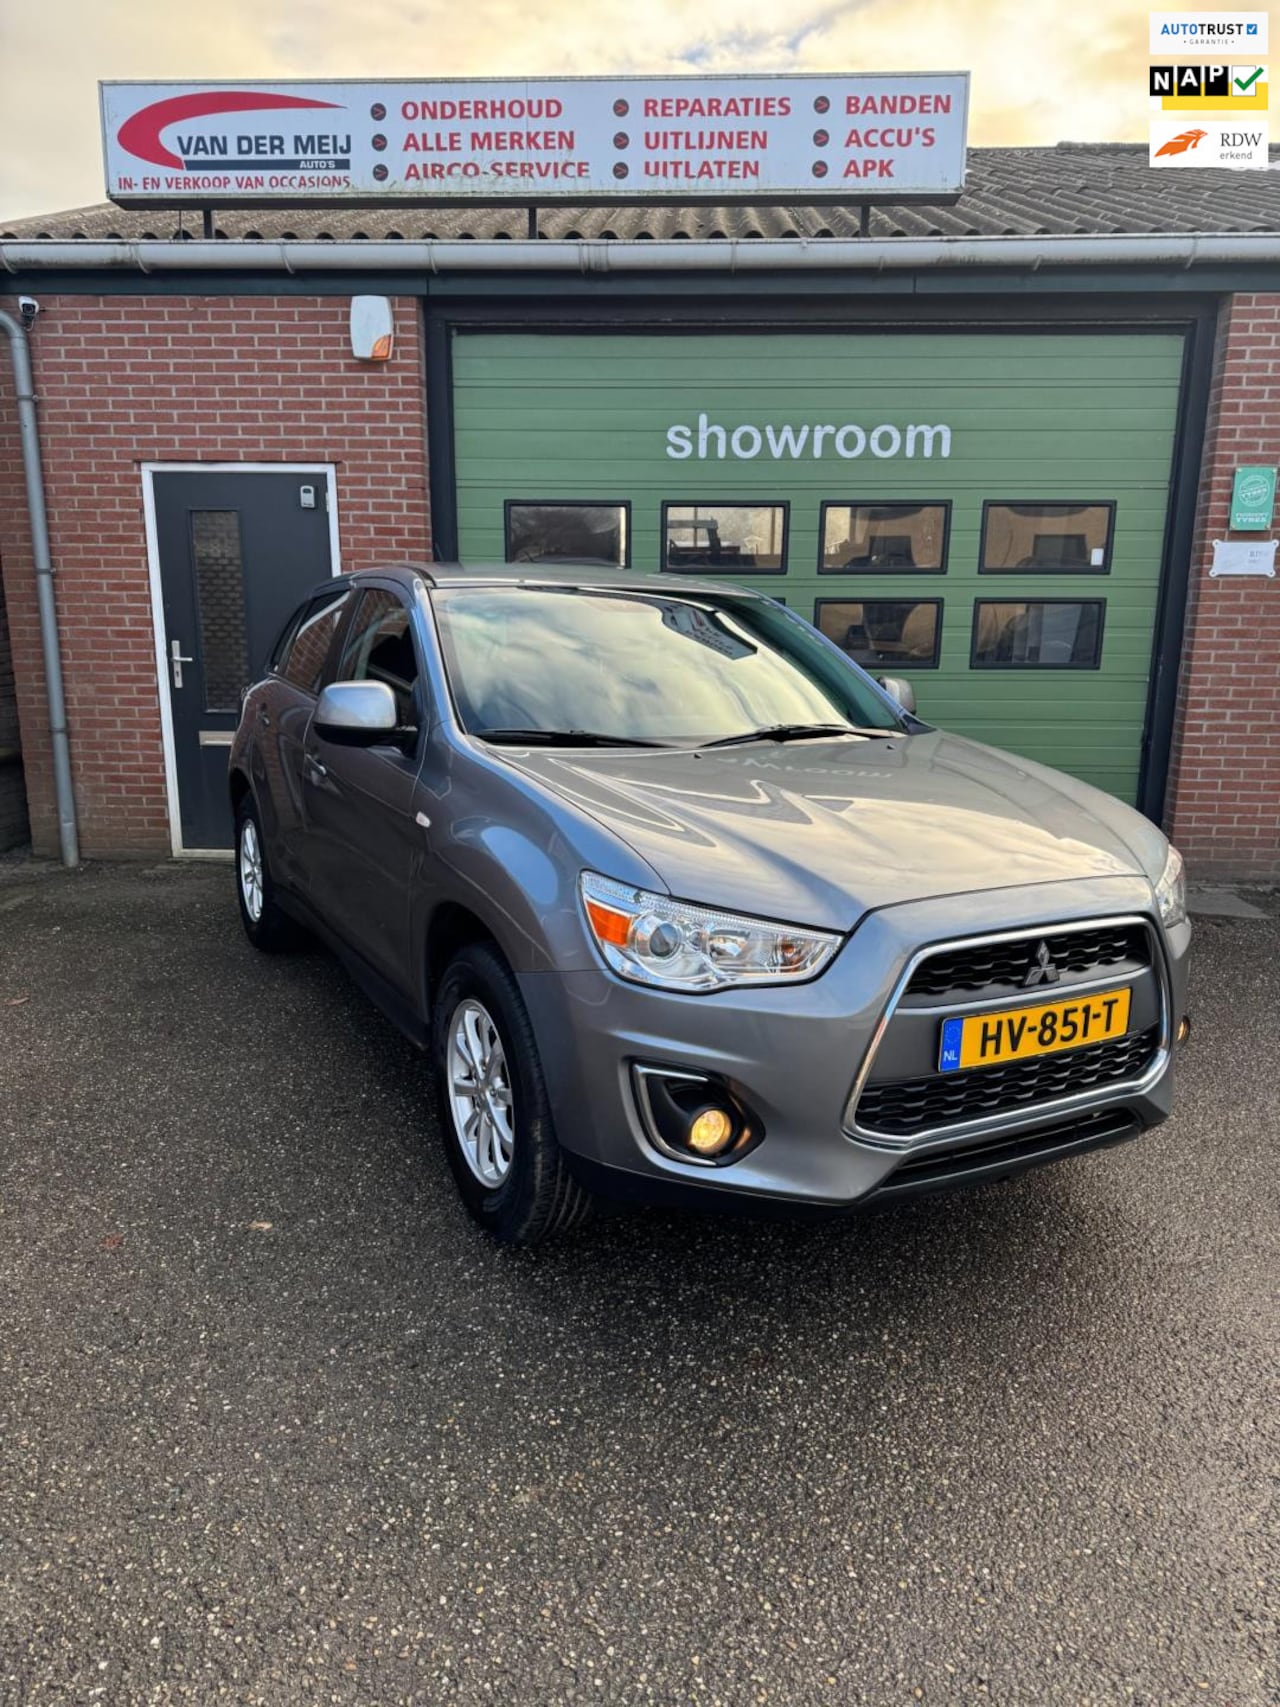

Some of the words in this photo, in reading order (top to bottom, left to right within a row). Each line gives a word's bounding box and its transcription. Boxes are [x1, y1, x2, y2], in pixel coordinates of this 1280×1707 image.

[401, 99, 563, 120] ONDERHOUD
[643, 97, 791, 118] REPARATIES
[845, 94, 951, 115] BANDEN
[177, 135, 228, 156] VAN
[237, 135, 285, 155] DER
[293, 134, 351, 155] MEIJ
[402, 132, 462, 152] ALLE
[470, 131, 575, 151] MERKEN
[644, 130, 768, 150] UITLIJNEN
[843, 127, 936, 149] ACCU'S
[300, 160, 336, 169] AUTO'S
[404, 161, 591, 181] AIRCO-SERVICE
[644, 160, 760, 180] UITLATEN
[843, 158, 894, 178] APK
[118, 176, 138, 190] IN-
[143, 176, 160, 190] EN
[165, 176, 231, 190] VERKOOP
[235, 175, 264, 189] VAN
[269, 175, 352, 189] OCCASIONS
[666, 413, 951, 459] showroom
[980, 998, 1119, 1058] HV-851-T
[943, 1050, 958, 1061] NL
